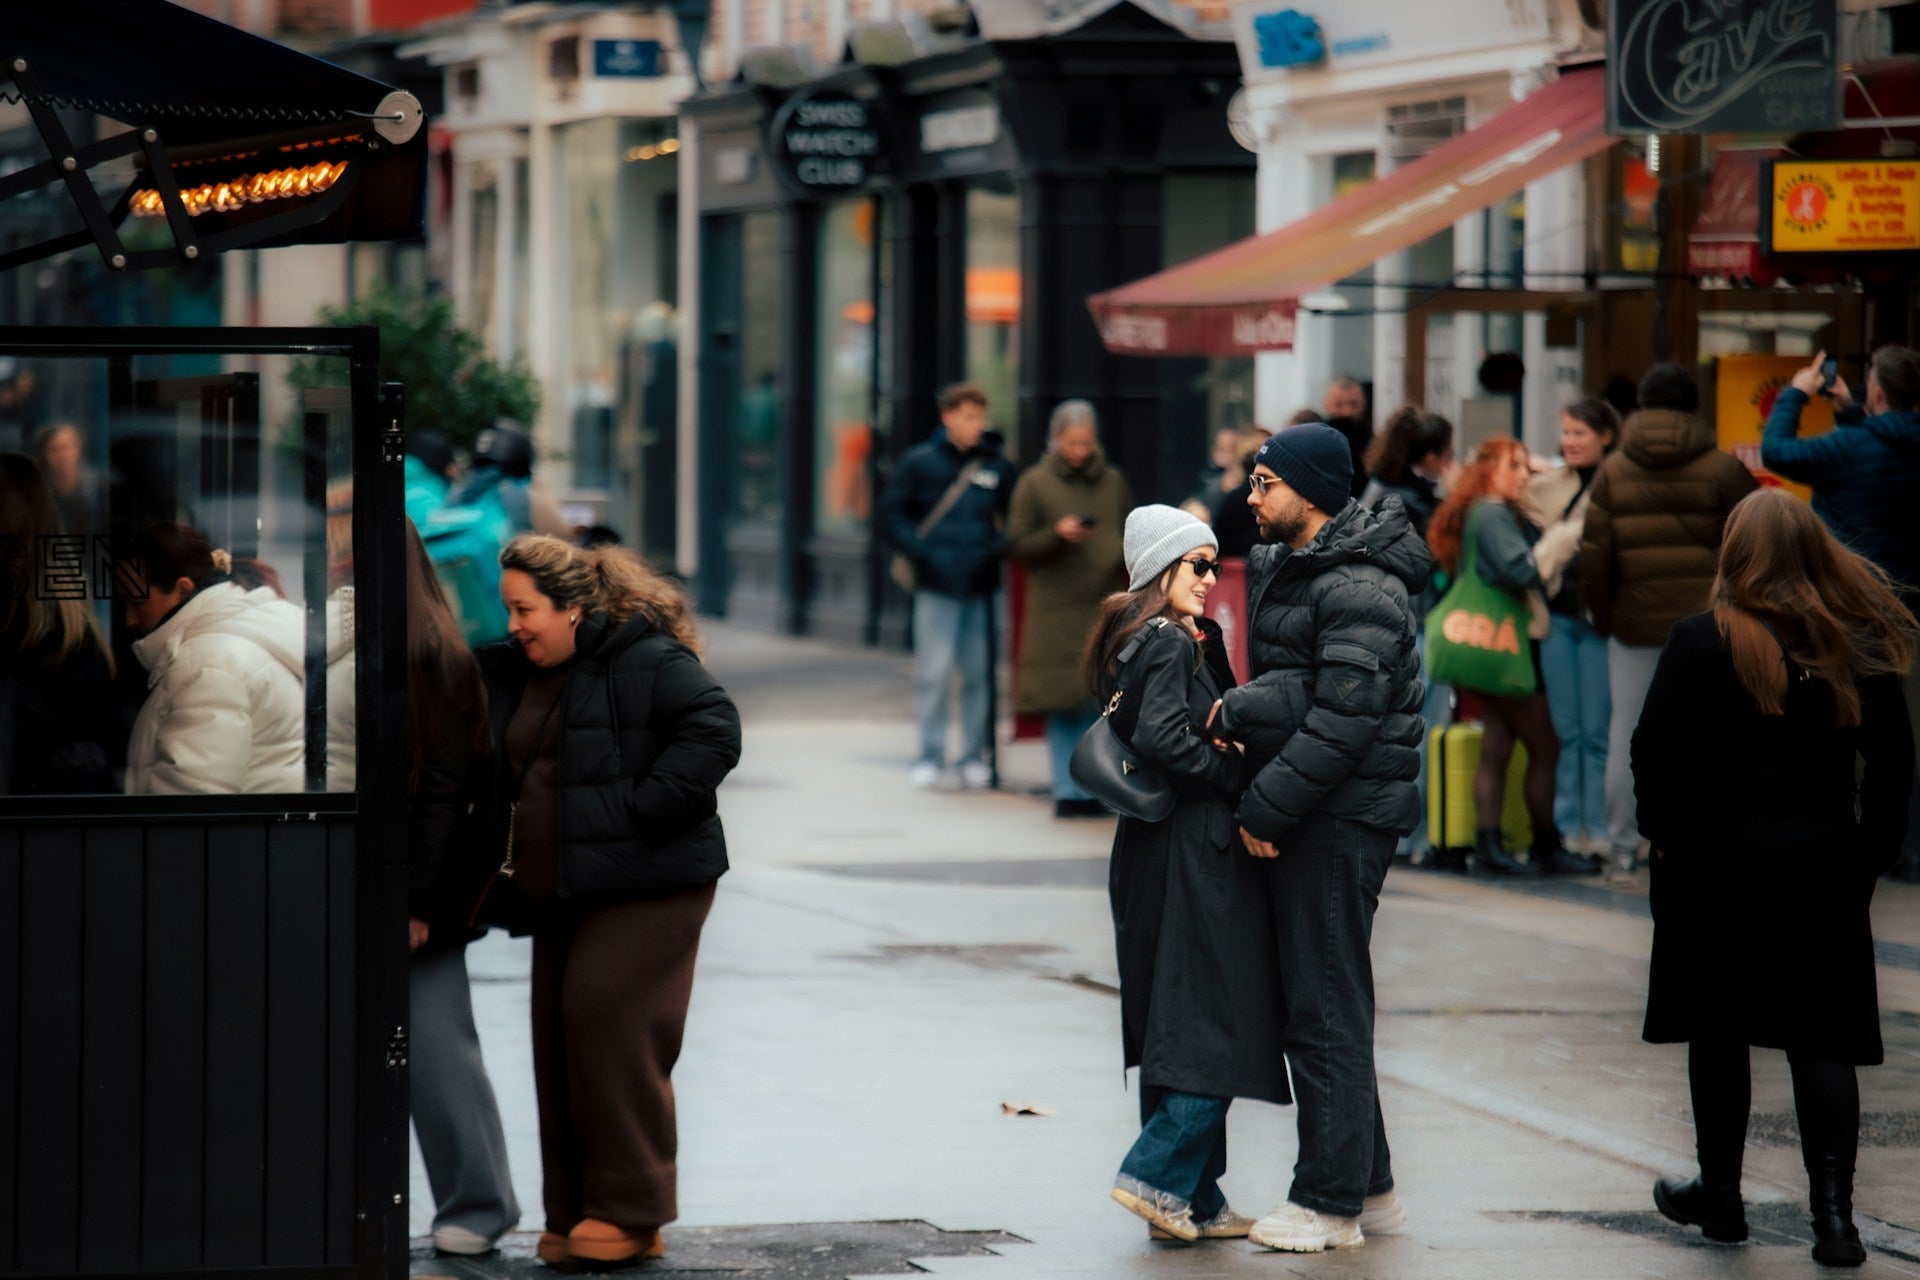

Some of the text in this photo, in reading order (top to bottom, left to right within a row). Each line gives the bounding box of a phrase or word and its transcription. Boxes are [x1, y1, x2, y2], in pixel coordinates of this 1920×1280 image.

[796, 101, 867, 128] SWISS
[1766, 101, 1828, 125] BAR
[785, 129, 878, 156] WATCH
[797, 156, 864, 185] CLUB
